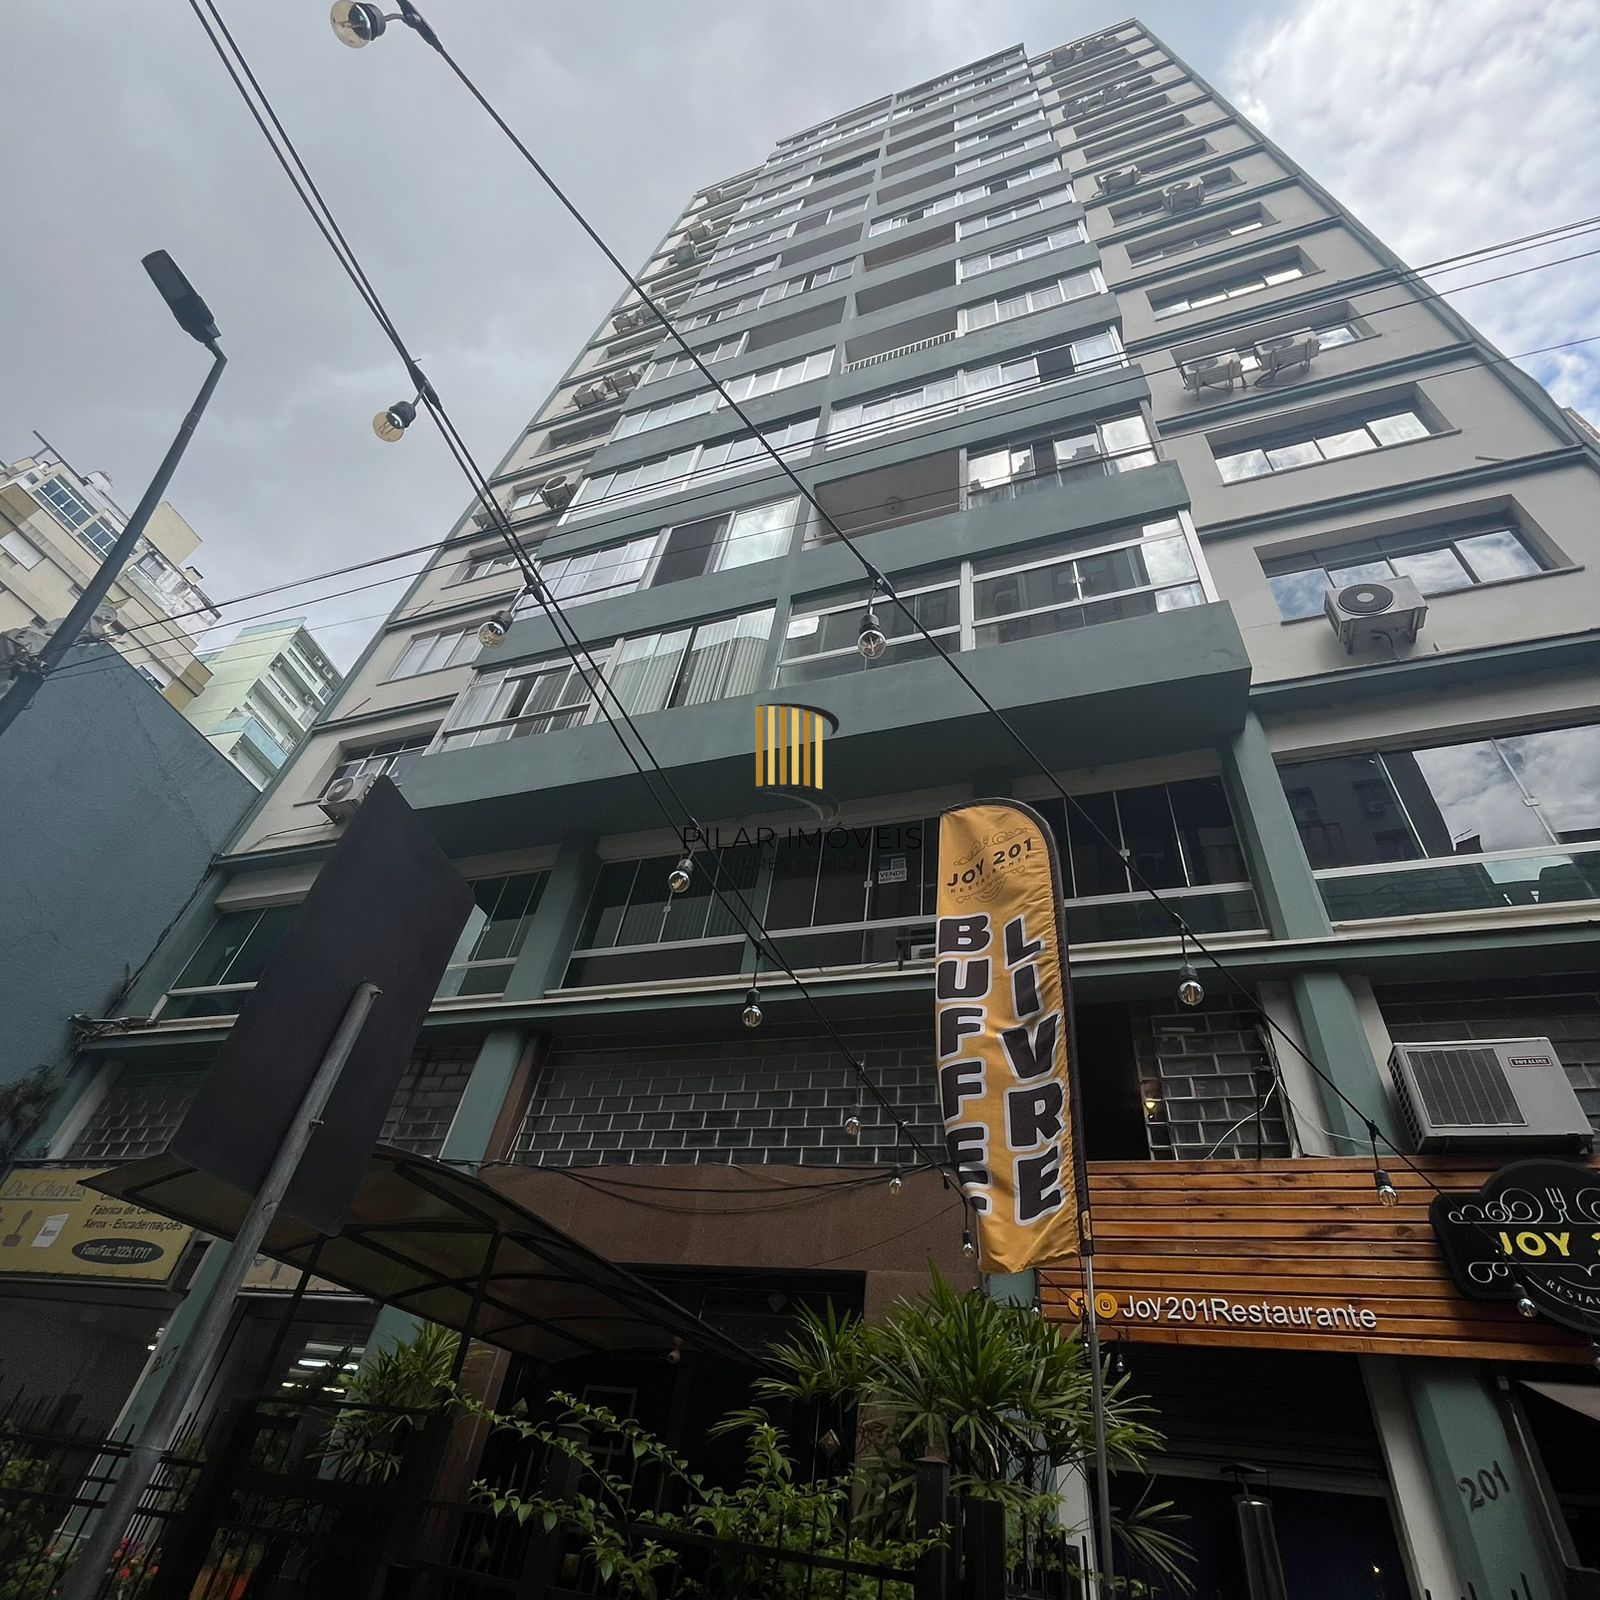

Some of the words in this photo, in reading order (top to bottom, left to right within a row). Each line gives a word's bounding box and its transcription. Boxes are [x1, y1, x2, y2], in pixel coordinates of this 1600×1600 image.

[947, 858, 984, 886] JOY
[993, 838, 1032, 865] 201
[937, 912, 992, 1215] BUFFE
[998, 914, 1065, 1226] LIVRE
[83, 1218, 108, 1229] Xerox
[1498, 1232, 1571, 1256] JOY
[1458, 1460, 1509, 1511] 201
